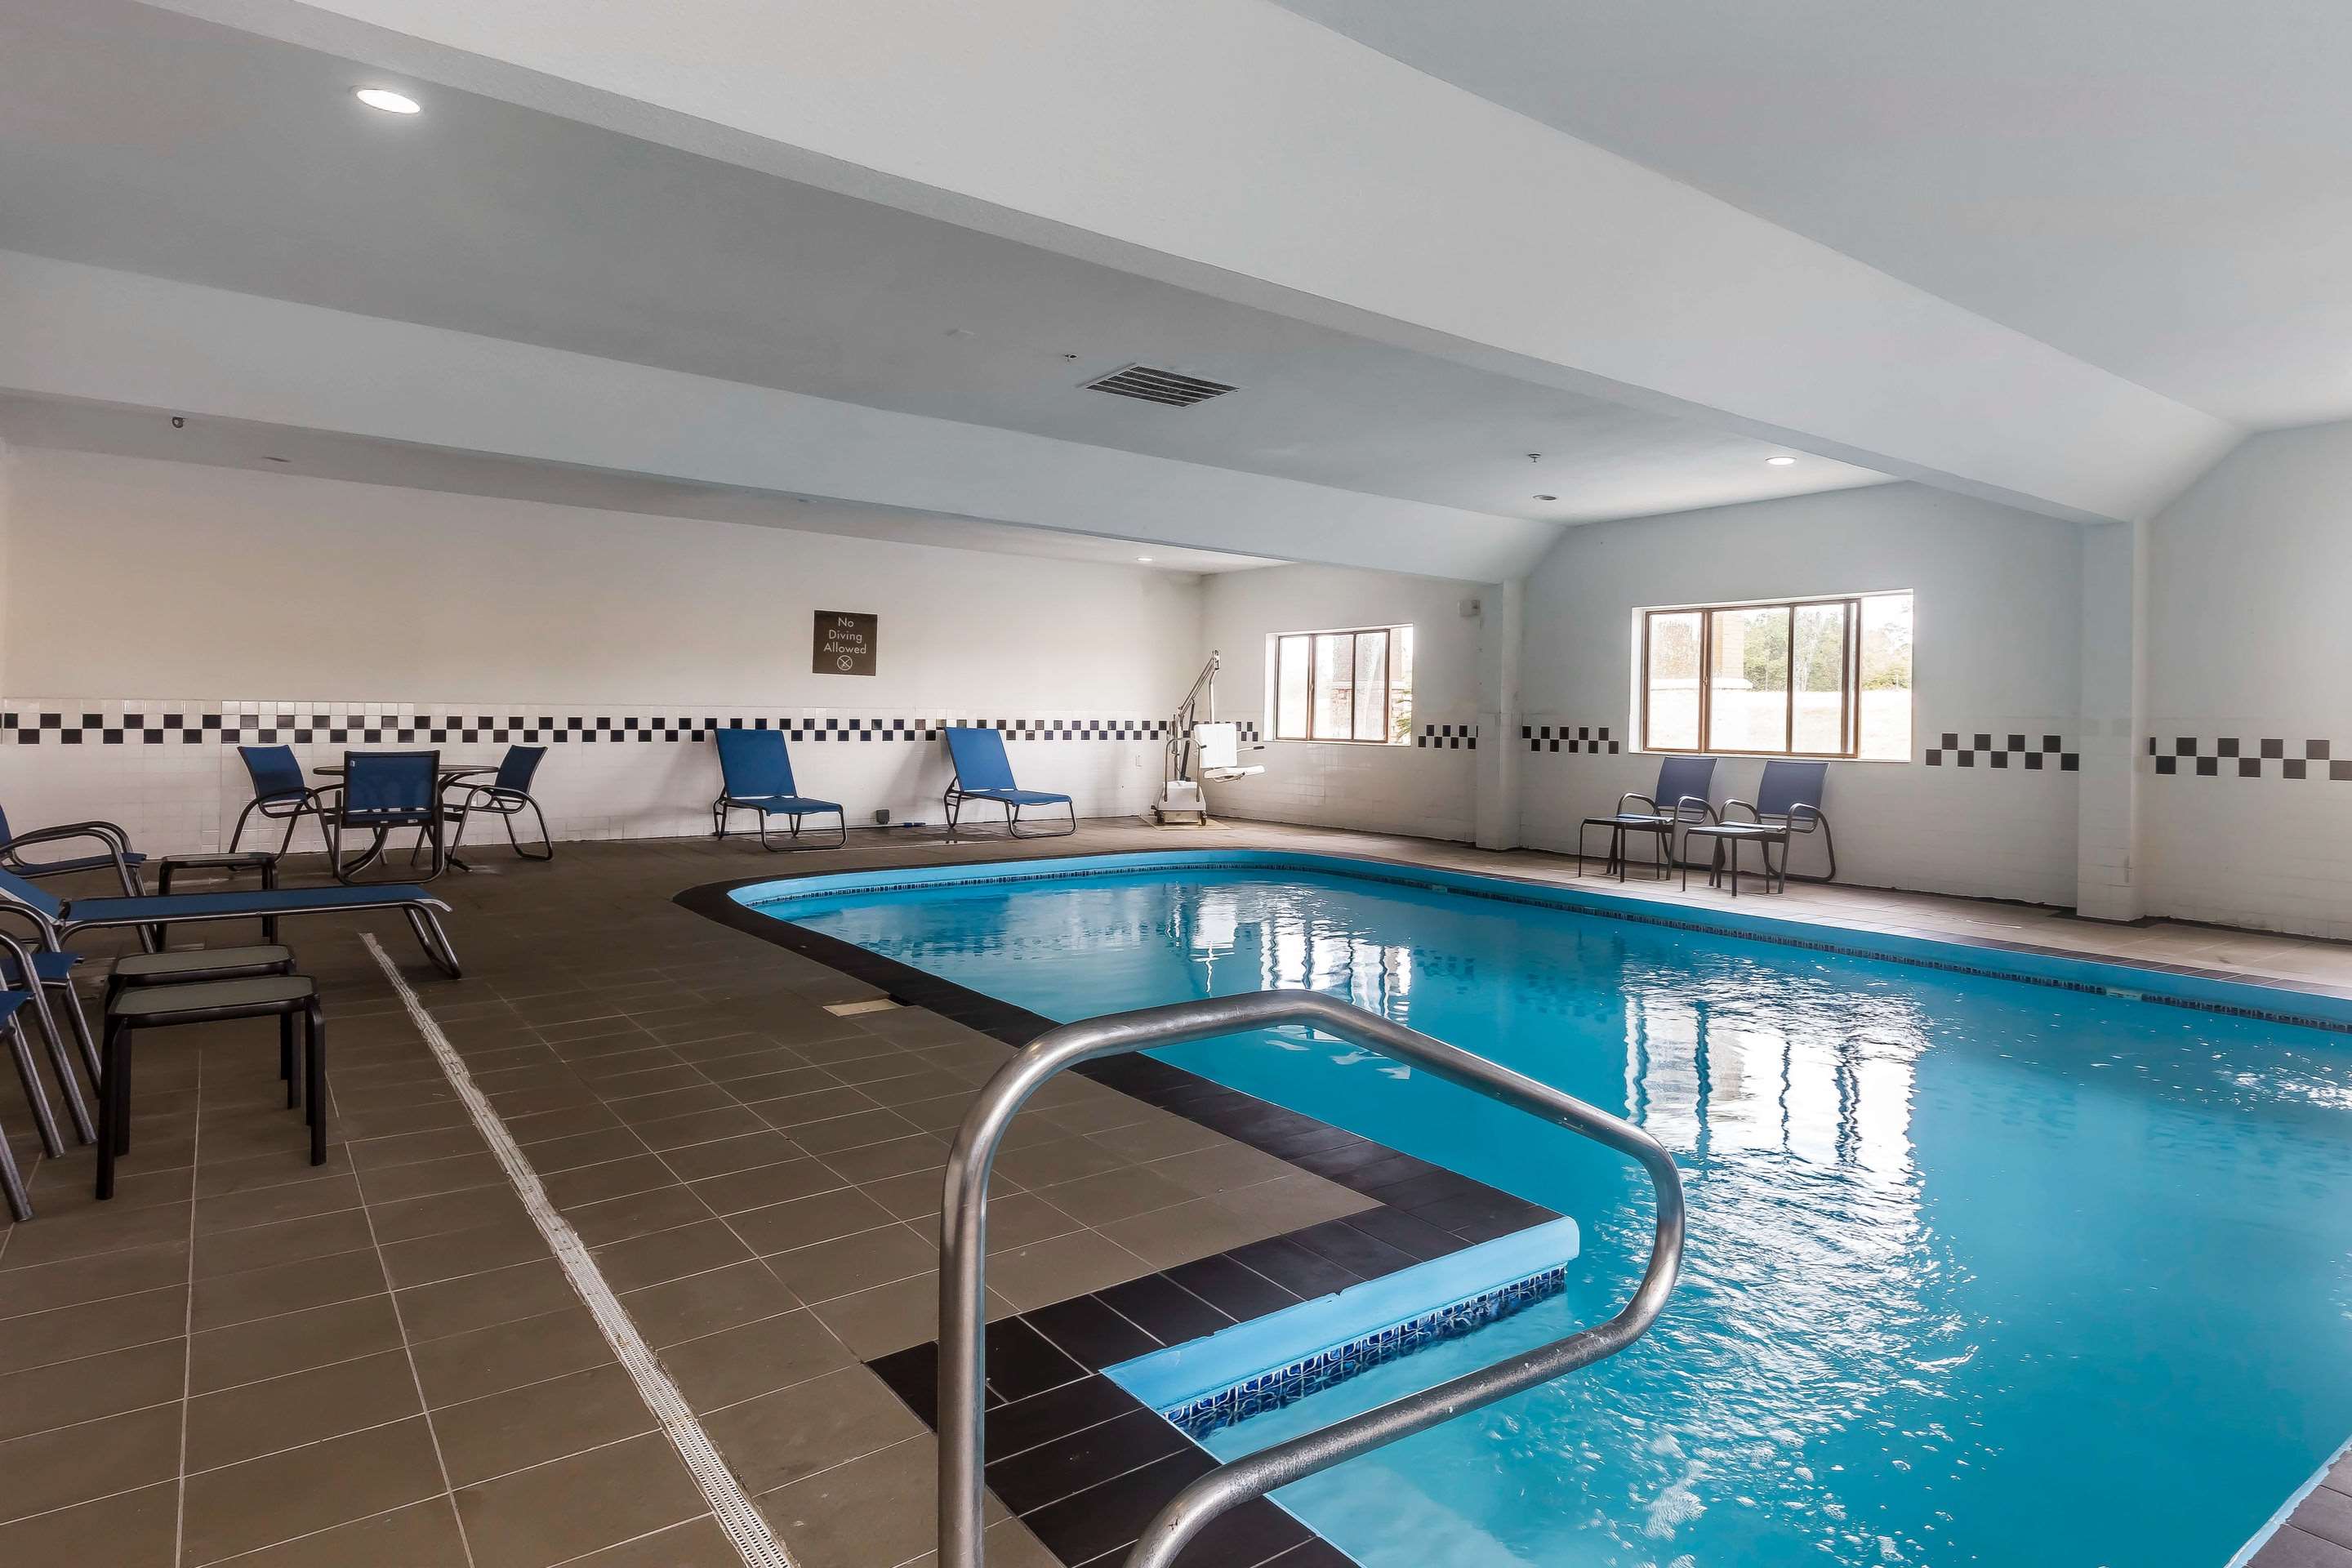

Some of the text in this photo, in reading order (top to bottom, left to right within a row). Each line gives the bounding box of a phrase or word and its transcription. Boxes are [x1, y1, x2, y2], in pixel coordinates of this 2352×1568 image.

[838, 617, 854, 627] No
[829, 629, 862, 644] Diving
[823, 642, 866, 654] Allowed
